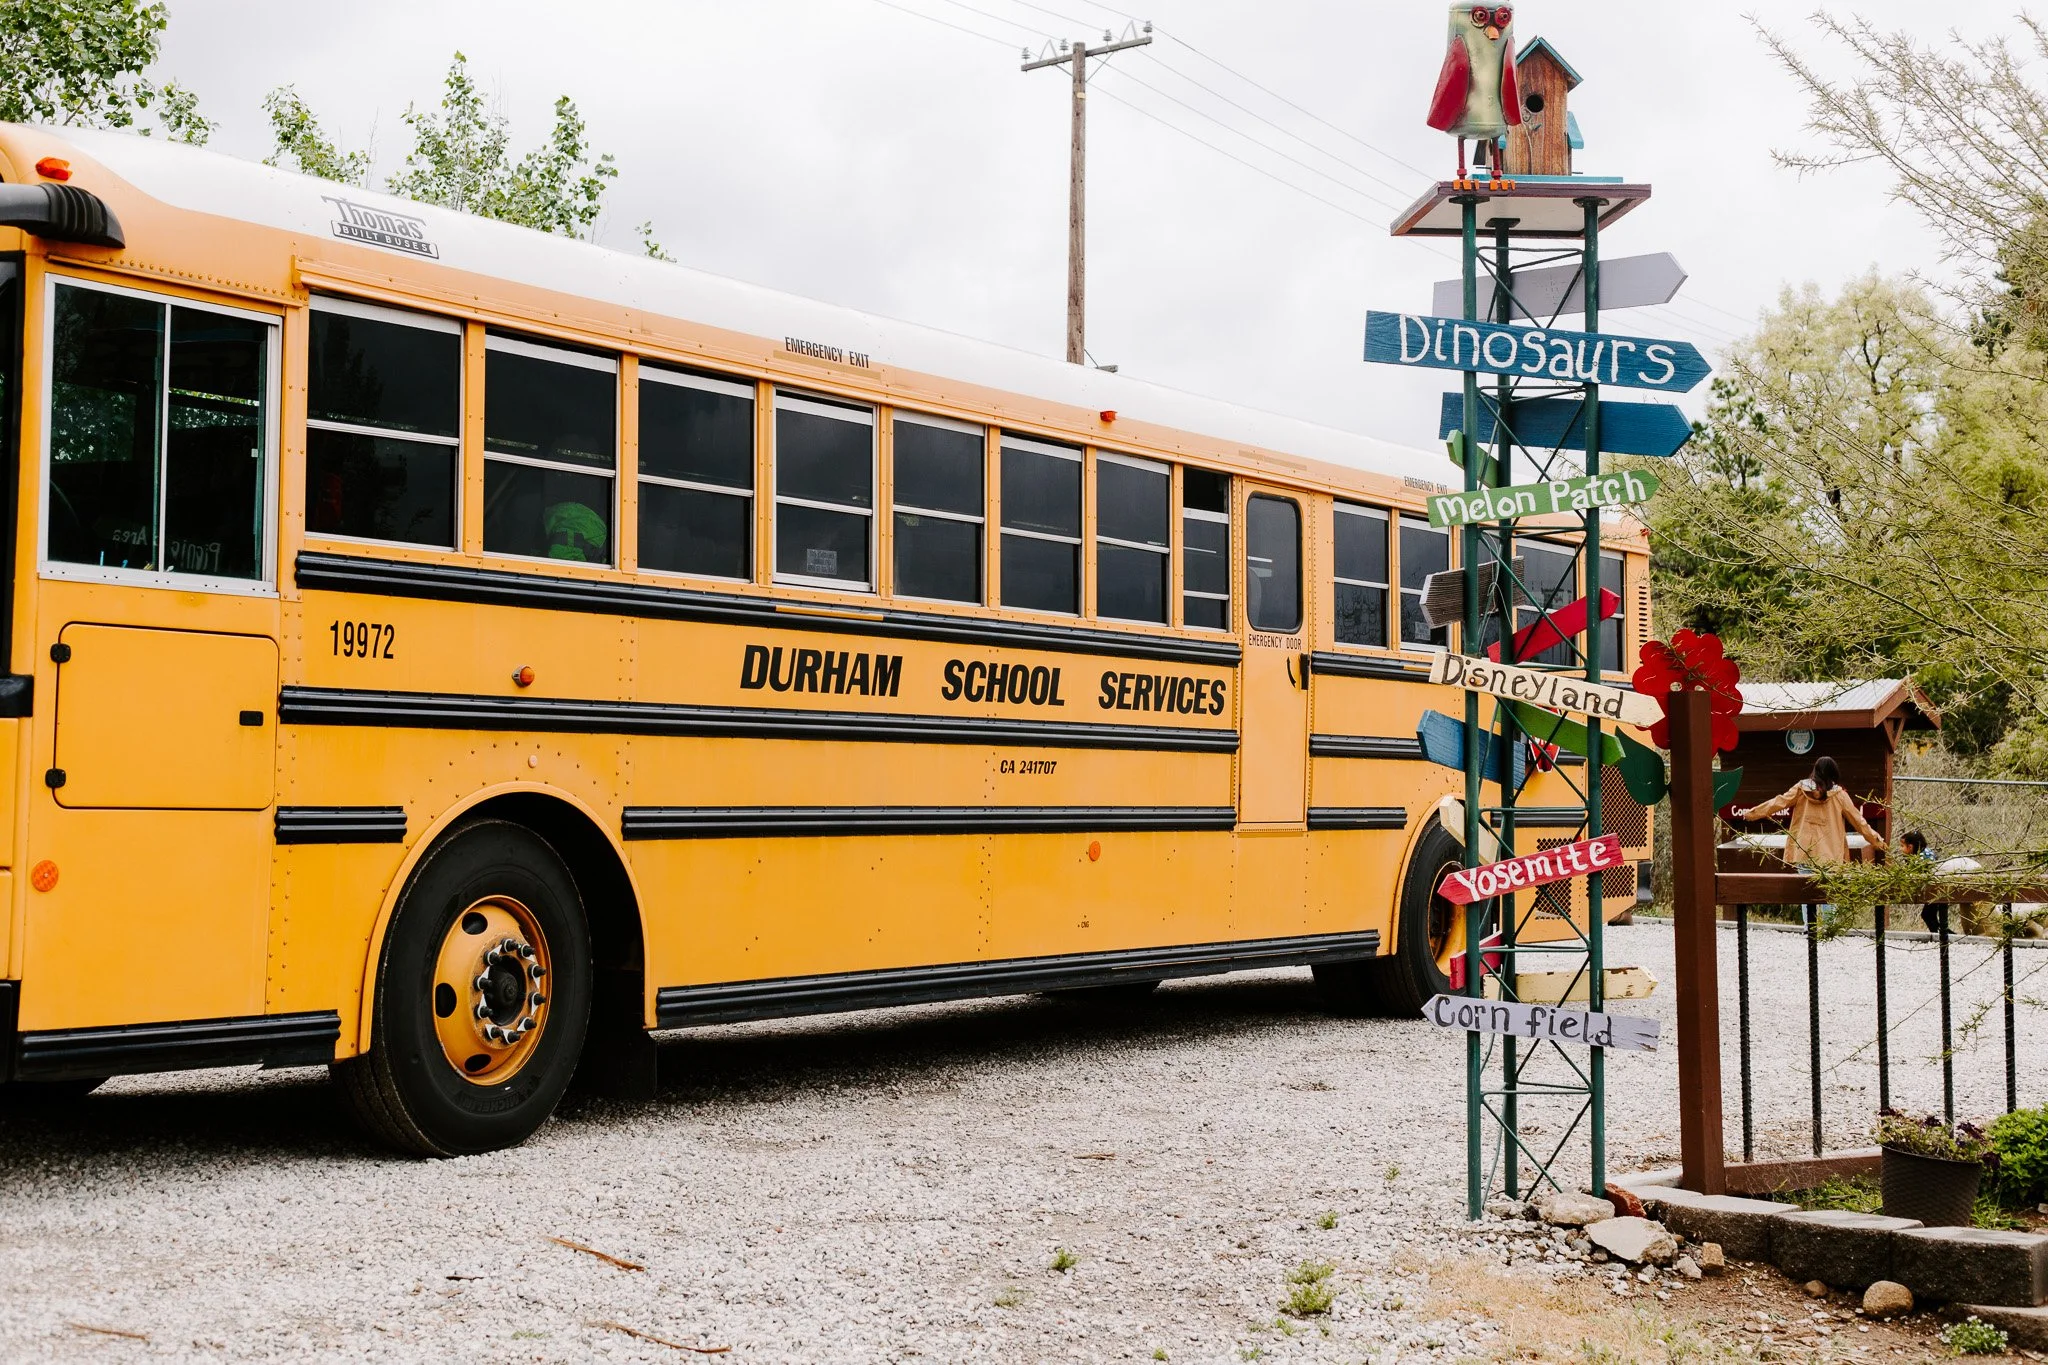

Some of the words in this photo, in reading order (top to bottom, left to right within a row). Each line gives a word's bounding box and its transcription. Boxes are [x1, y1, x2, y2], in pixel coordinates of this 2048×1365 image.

[321, 195, 426, 240] Thomas
[342, 225, 379, 241] BUILT
[385, 234, 431, 252] BUSES
[785, 336, 843, 363] EMERGENCY
[849, 351, 869, 368] EXIT
[1400, 314, 1676, 384] Dinosaurs
[1404, 476, 1434, 492] EMERGENCY
[1436, 483, 1448, 495] EXIT
[1549, 471, 1647, 513] Patch
[330, 620, 394, 659] 19972
[1248, 633, 1282, 649] EMERGENCY
[1286, 637, 1302, 650] DOOR
[740, 644, 903, 697] DURHAM
[941, 659, 1065, 707] SCHOOL
[1098, 670, 1226, 716] SERVICES
[1441, 653, 1624, 719] Disneyland
[1000, 760, 1015, 774] CA
[1019, 760, 1057, 774] 241707
[1454, 841, 1611, 901] Yosemite
[1434, 996, 1511, 1032] Corn
[1525, 1006, 1615, 1048] field
